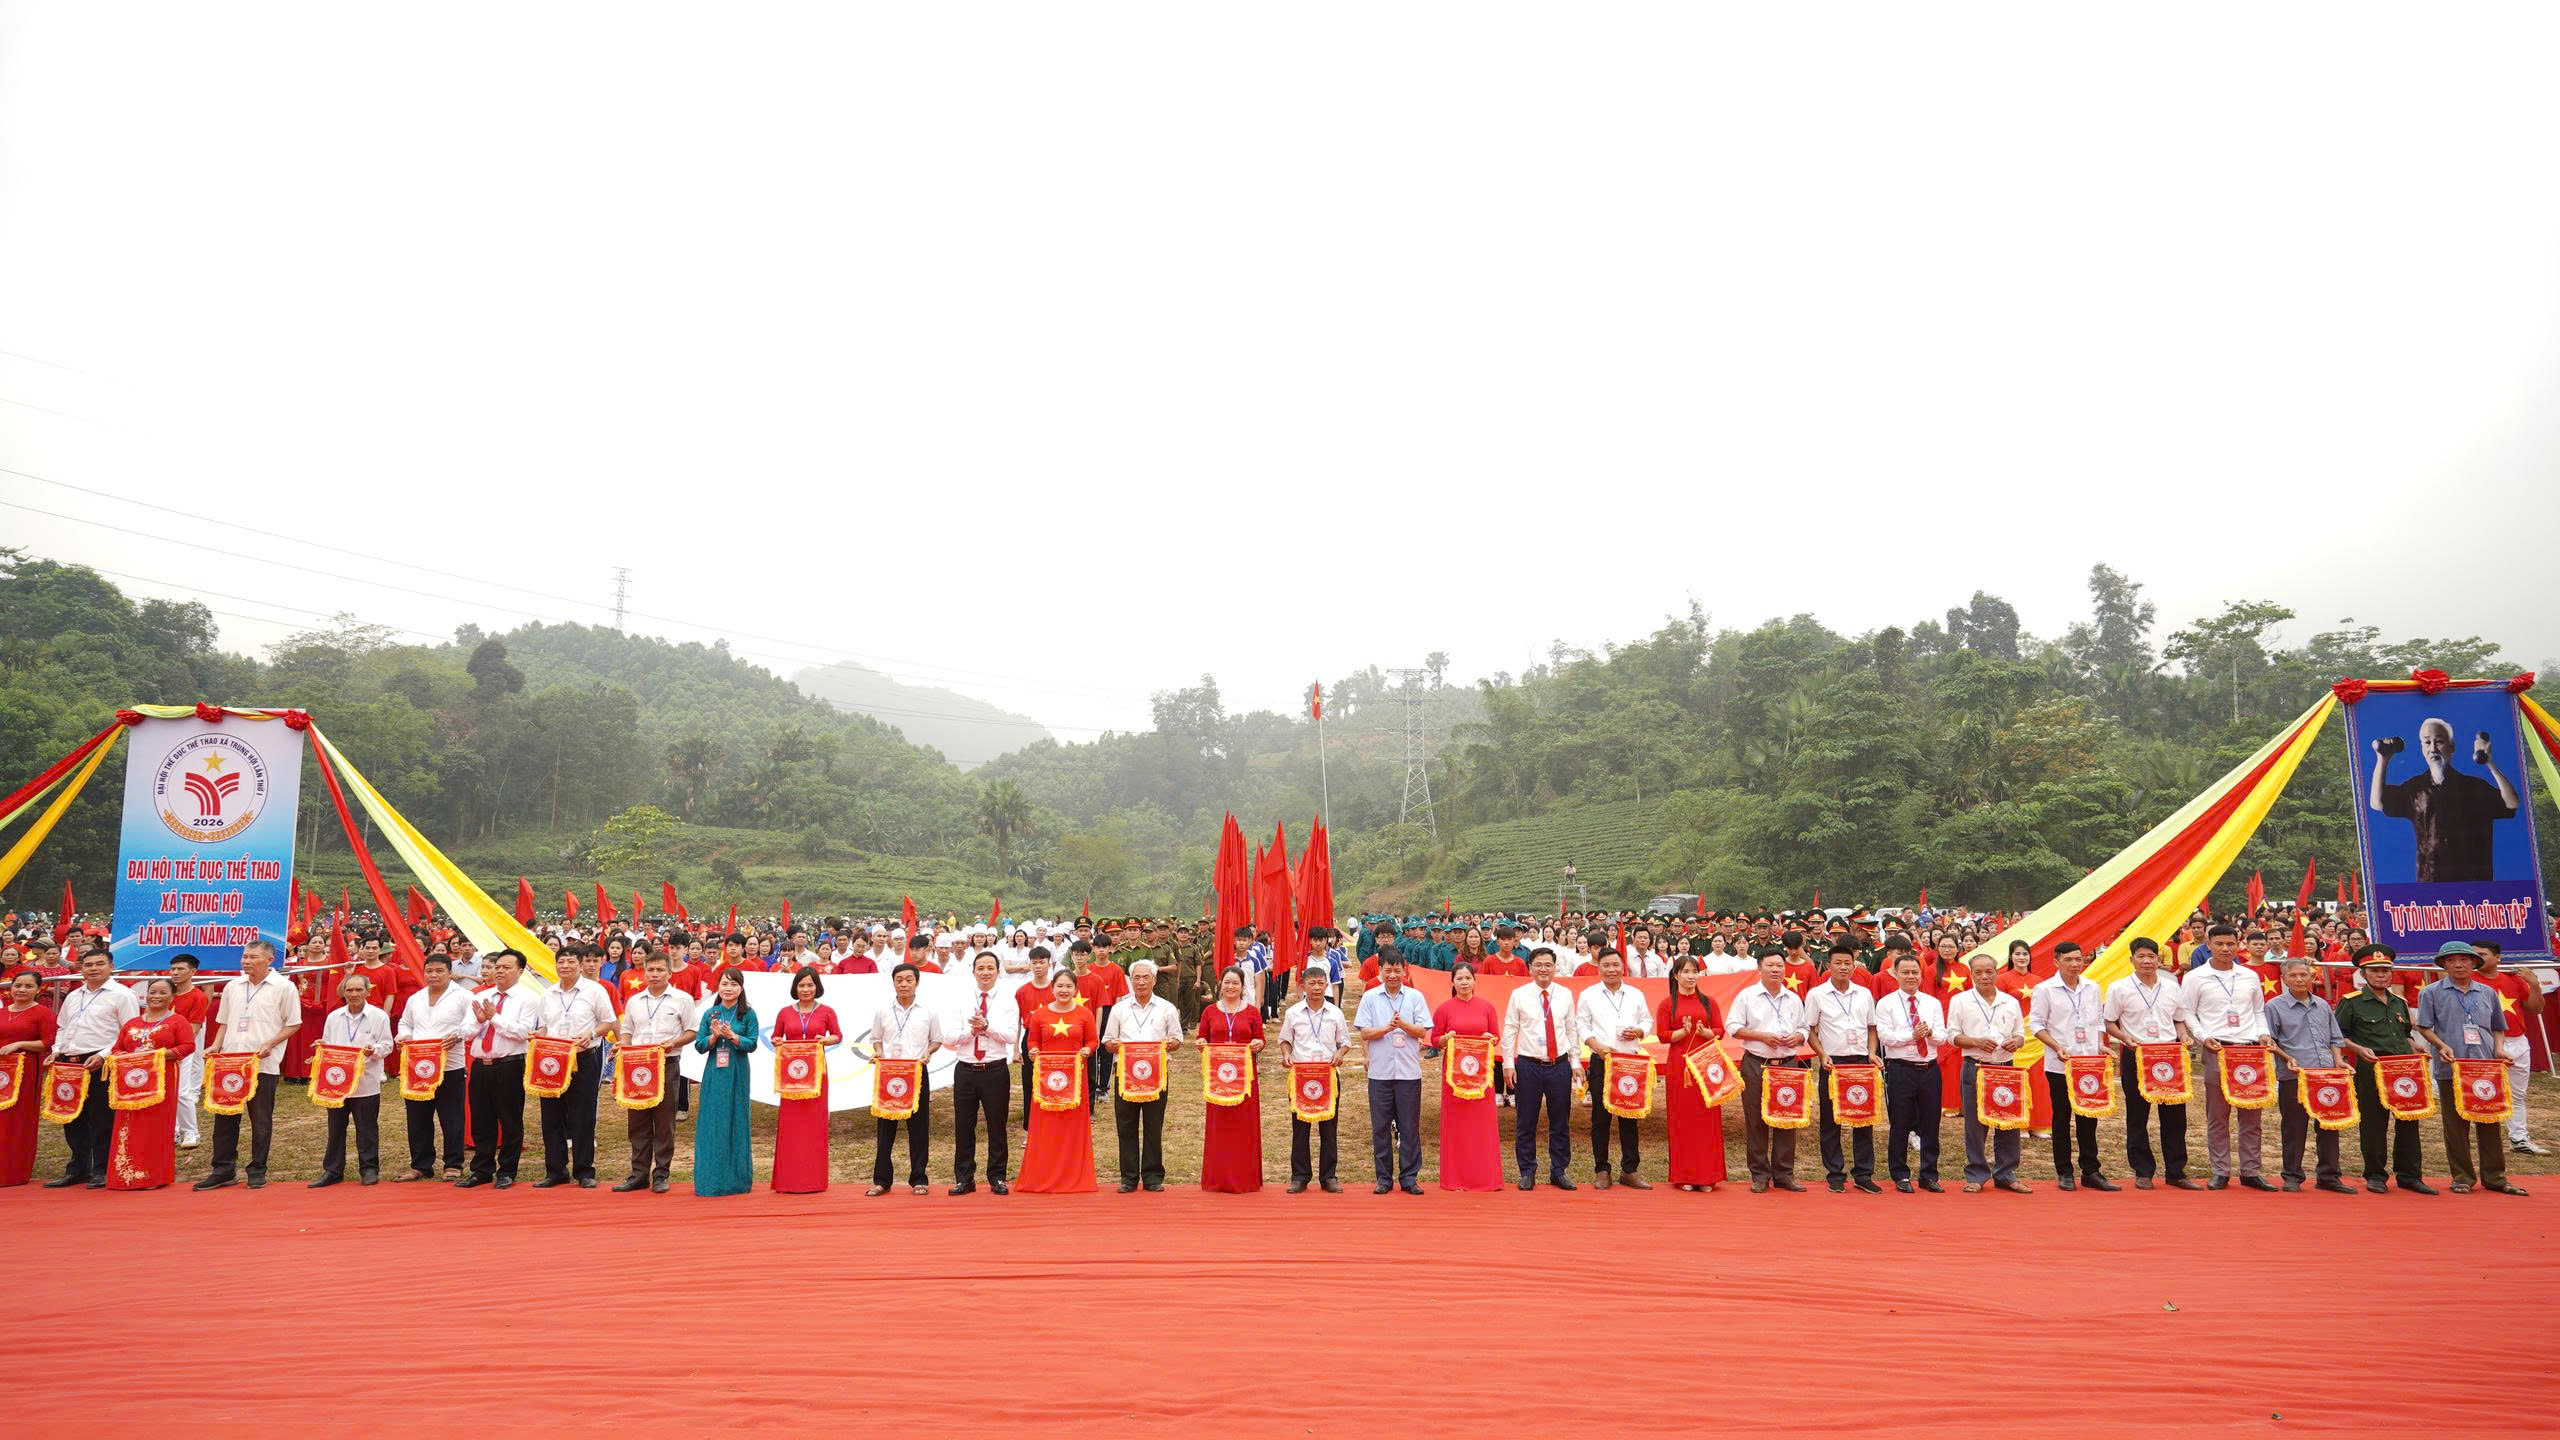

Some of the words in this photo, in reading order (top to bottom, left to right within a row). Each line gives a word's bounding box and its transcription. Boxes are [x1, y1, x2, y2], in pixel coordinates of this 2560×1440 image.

[200, 738, 217, 746] THAO
[220, 737, 228, 746] XÃ
[174, 748, 187, 760] DỤC
[230, 741, 249, 757] TRUNG
[160, 771, 168, 783] HỘI
[158, 784, 166, 794] ĐẠI
[193, 818, 225, 827] 2026
[127, 860, 149, 884] ĐẠI
[151, 857, 172, 884] HỘI
[174, 852, 198, 880] THỂ
[199, 860, 223, 884] DỤC
[226, 852, 249, 880] THỂ
[251, 860, 281, 880] THAO
[161, 889, 177, 913] XÃ
[180, 892, 219, 912] TRUNG
[221, 889, 243, 917] HỘI
[2405, 901, 2423, 931] TÔI
[2422, 900, 2452, 931] NGÀY
[2452, 899, 2476, 930] NÀO
[2475, 900, 2507, 930] CŨNG
[138, 919, 163, 945] LẦN
[166, 921, 190, 945] THỨ
[191, 926, 197, 945] I
[199, 921, 227, 945] NĂM
[229, 926, 259, 945] 2026
